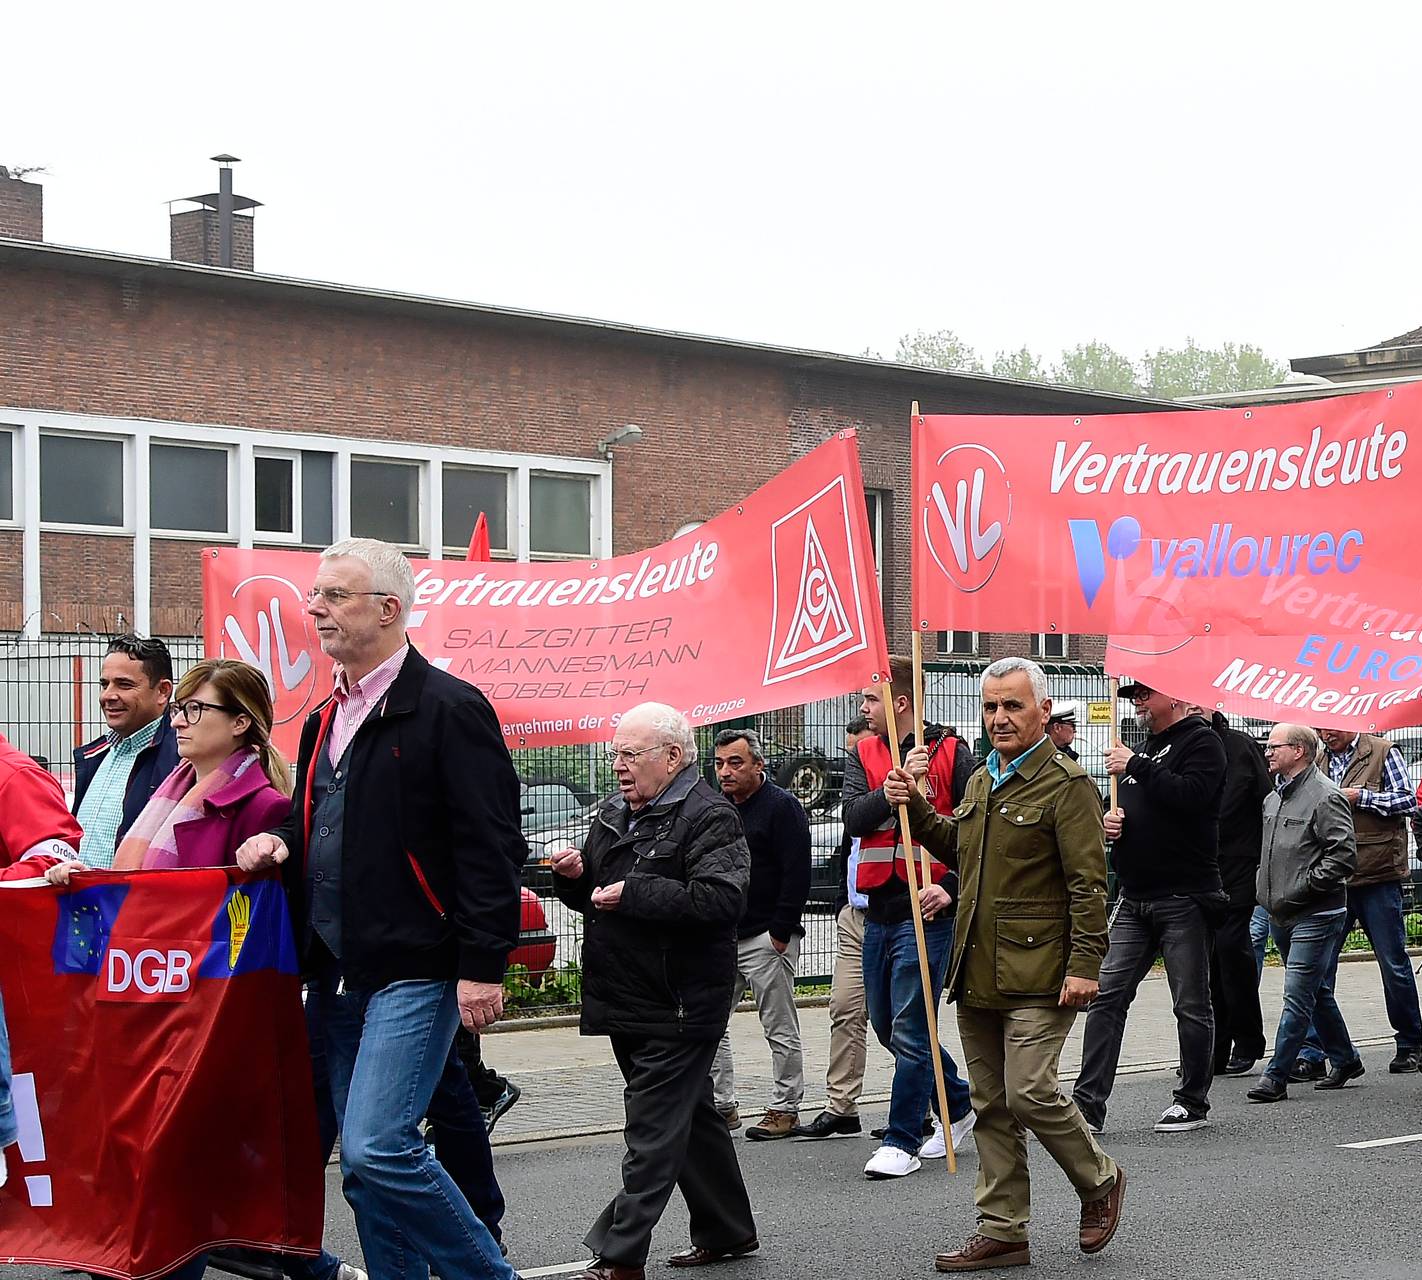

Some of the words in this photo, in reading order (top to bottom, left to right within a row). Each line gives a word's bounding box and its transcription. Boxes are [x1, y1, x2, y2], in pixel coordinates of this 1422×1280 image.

[1050, 422, 1407, 494] Vertrauensleute
[931, 468, 1003, 574] VL
[1151, 523, 1364, 579] vallourec
[444, 617, 673, 650] SALZGITTER
[460, 641, 703, 675] MANNESMANN
[475, 678, 649, 701] ROBBLECH
[1212, 657, 1379, 717] Mülheim
[500, 717, 573, 737] ernehmen
[578, 714, 604, 730] der
[692, 696, 746, 719] Gruppe
[107, 948, 193, 994] DGB
